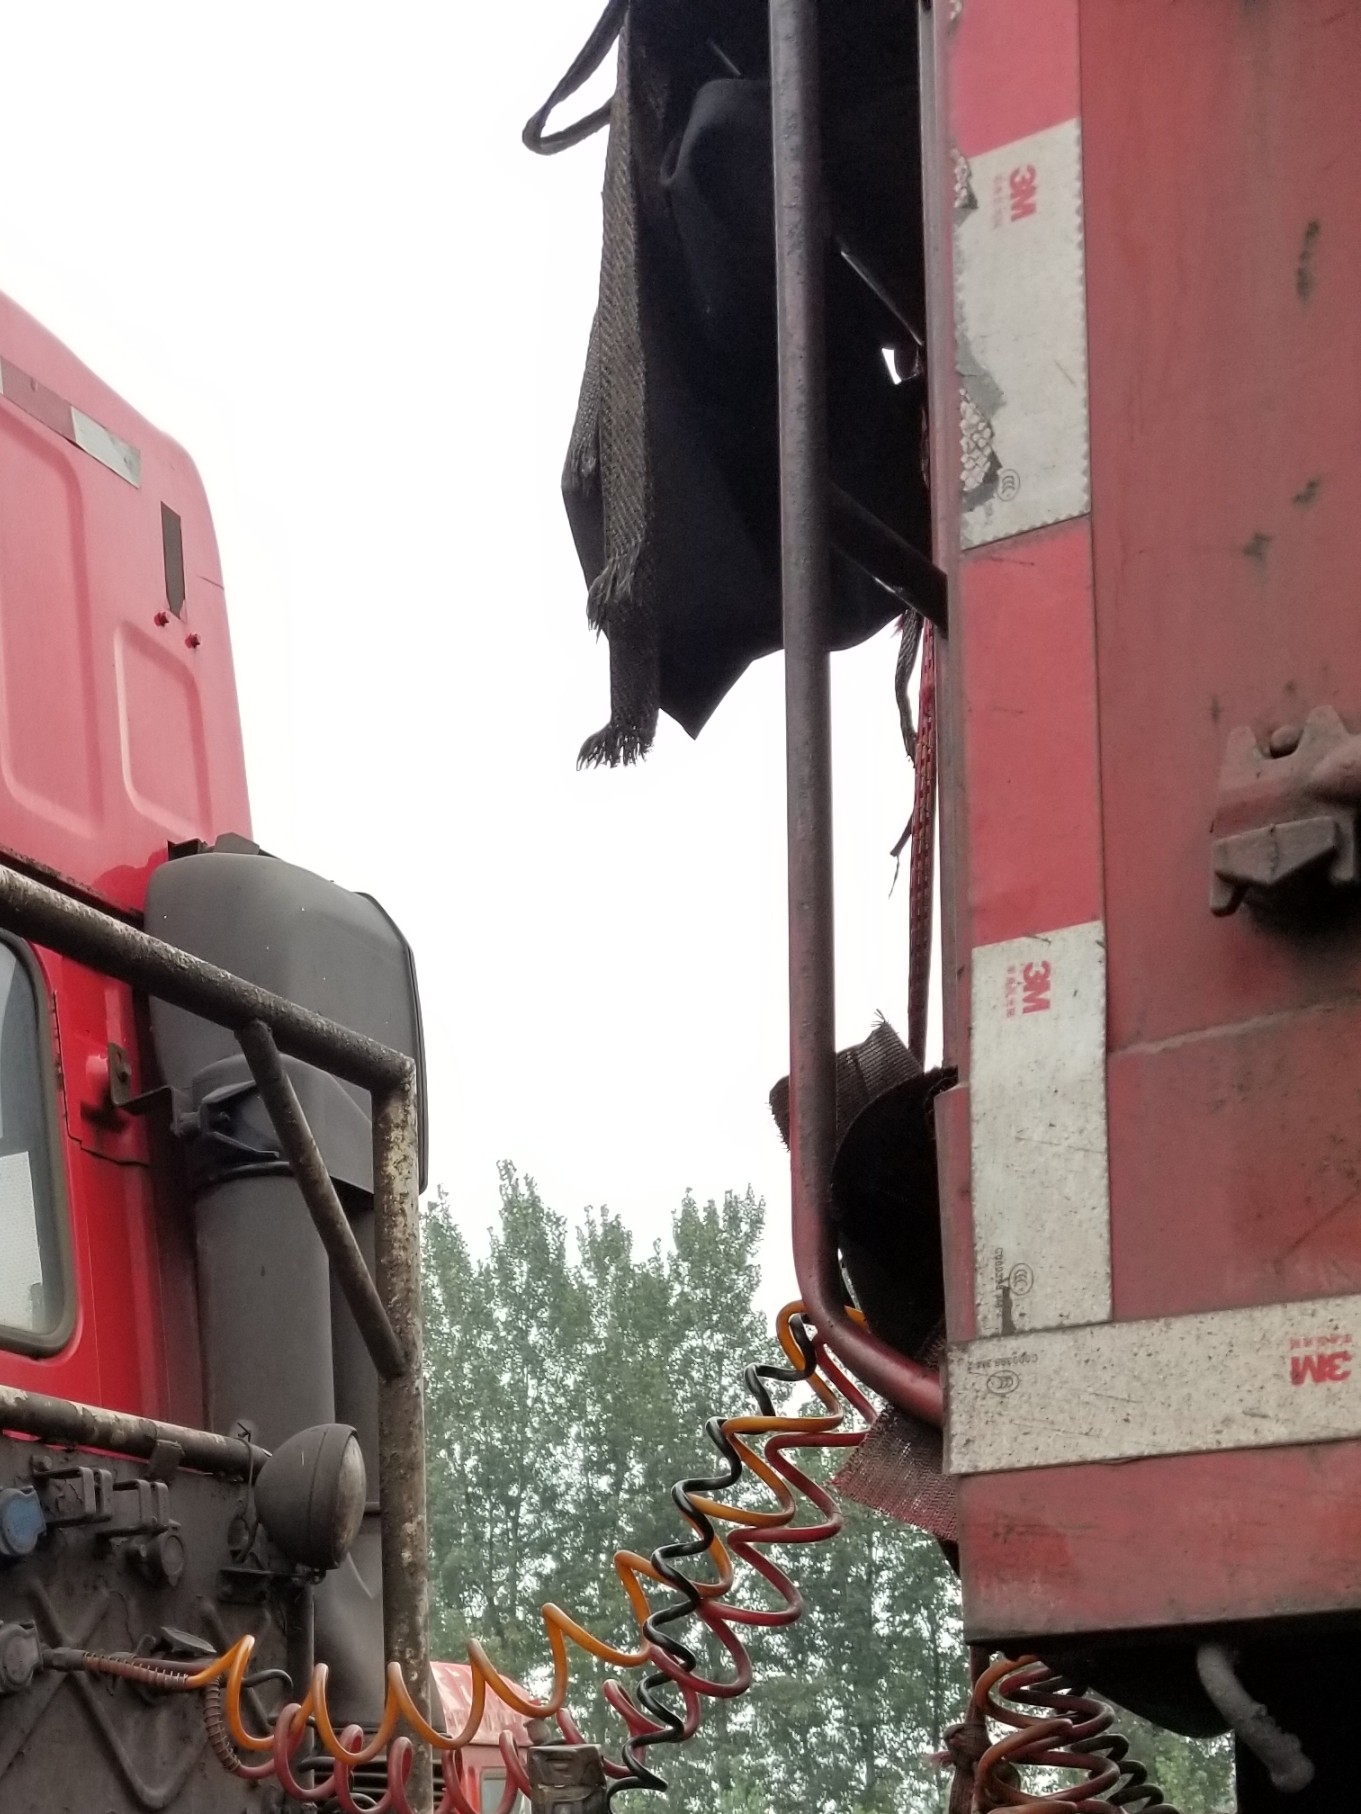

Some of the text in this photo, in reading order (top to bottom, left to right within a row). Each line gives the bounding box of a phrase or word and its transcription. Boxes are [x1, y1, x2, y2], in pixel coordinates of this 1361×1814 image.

[1009, 165, 1037, 222] 3M
[1022, 960, 1051, 1014] 3M
[1290, 1350, 1352, 1386] 3M
